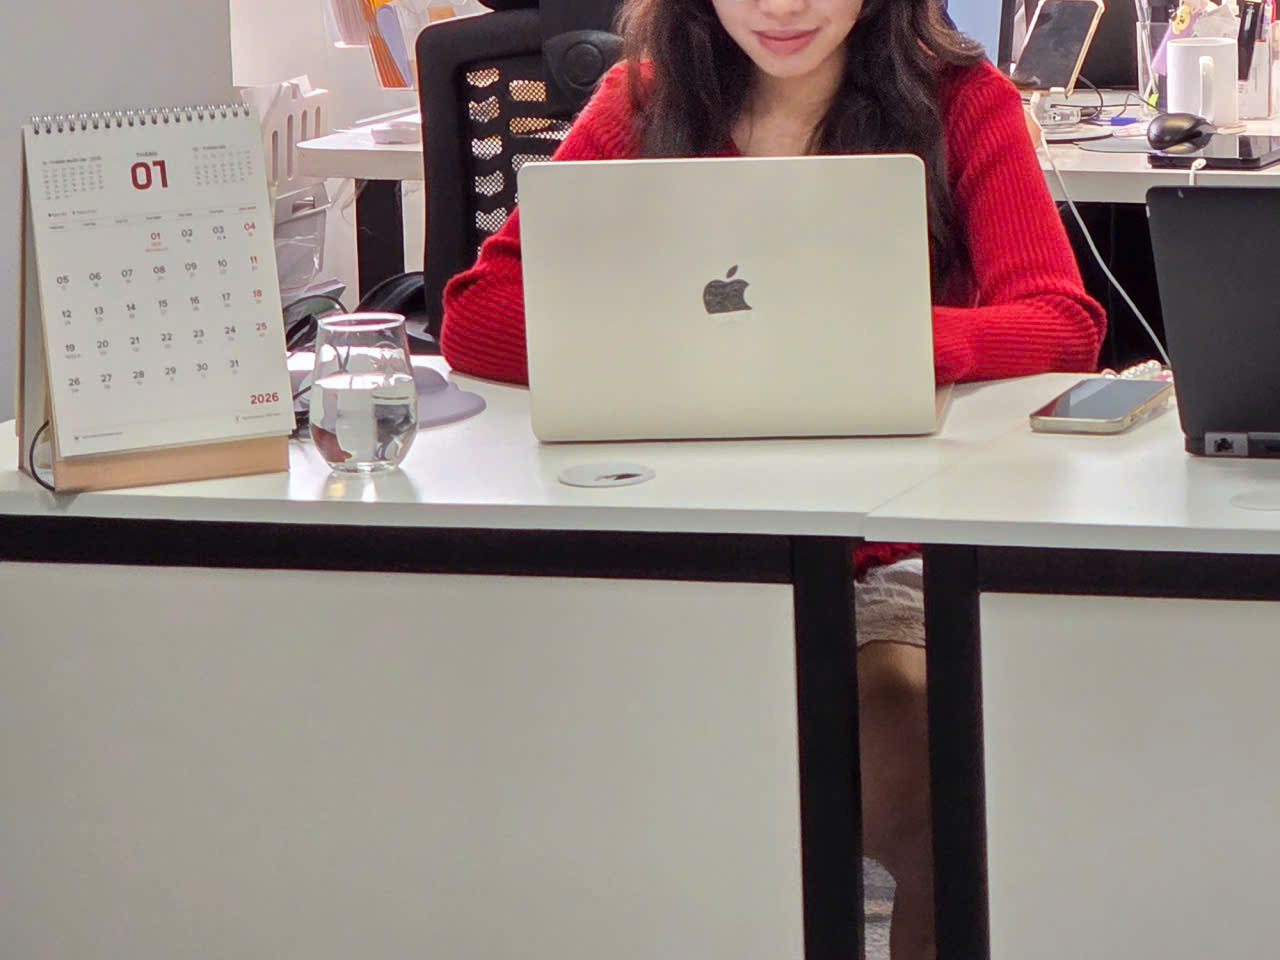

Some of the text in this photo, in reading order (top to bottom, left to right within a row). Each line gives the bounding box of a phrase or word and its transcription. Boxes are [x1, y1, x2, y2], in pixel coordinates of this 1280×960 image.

[131, 160, 168, 190] 01
[150, 222, 255, 240] 01 02 03 04
[56, 256, 258, 284] 05 06 07 08 09 10 11
[62, 310, 71, 318] 12
[94, 306, 104, 315] 13
[158, 300, 168, 308] 15
[190, 296, 200, 304] 16
[222, 292, 231, 301] 17
[97, 340, 109, 349] 20
[130, 336, 140, 345] 21
[161, 333, 173, 341] 22
[193, 329, 204, 338] 23
[224, 325, 236, 334] 24
[68, 360, 239, 386] 26 27 28 29 30 31
[250, 392, 279, 405] 2026
